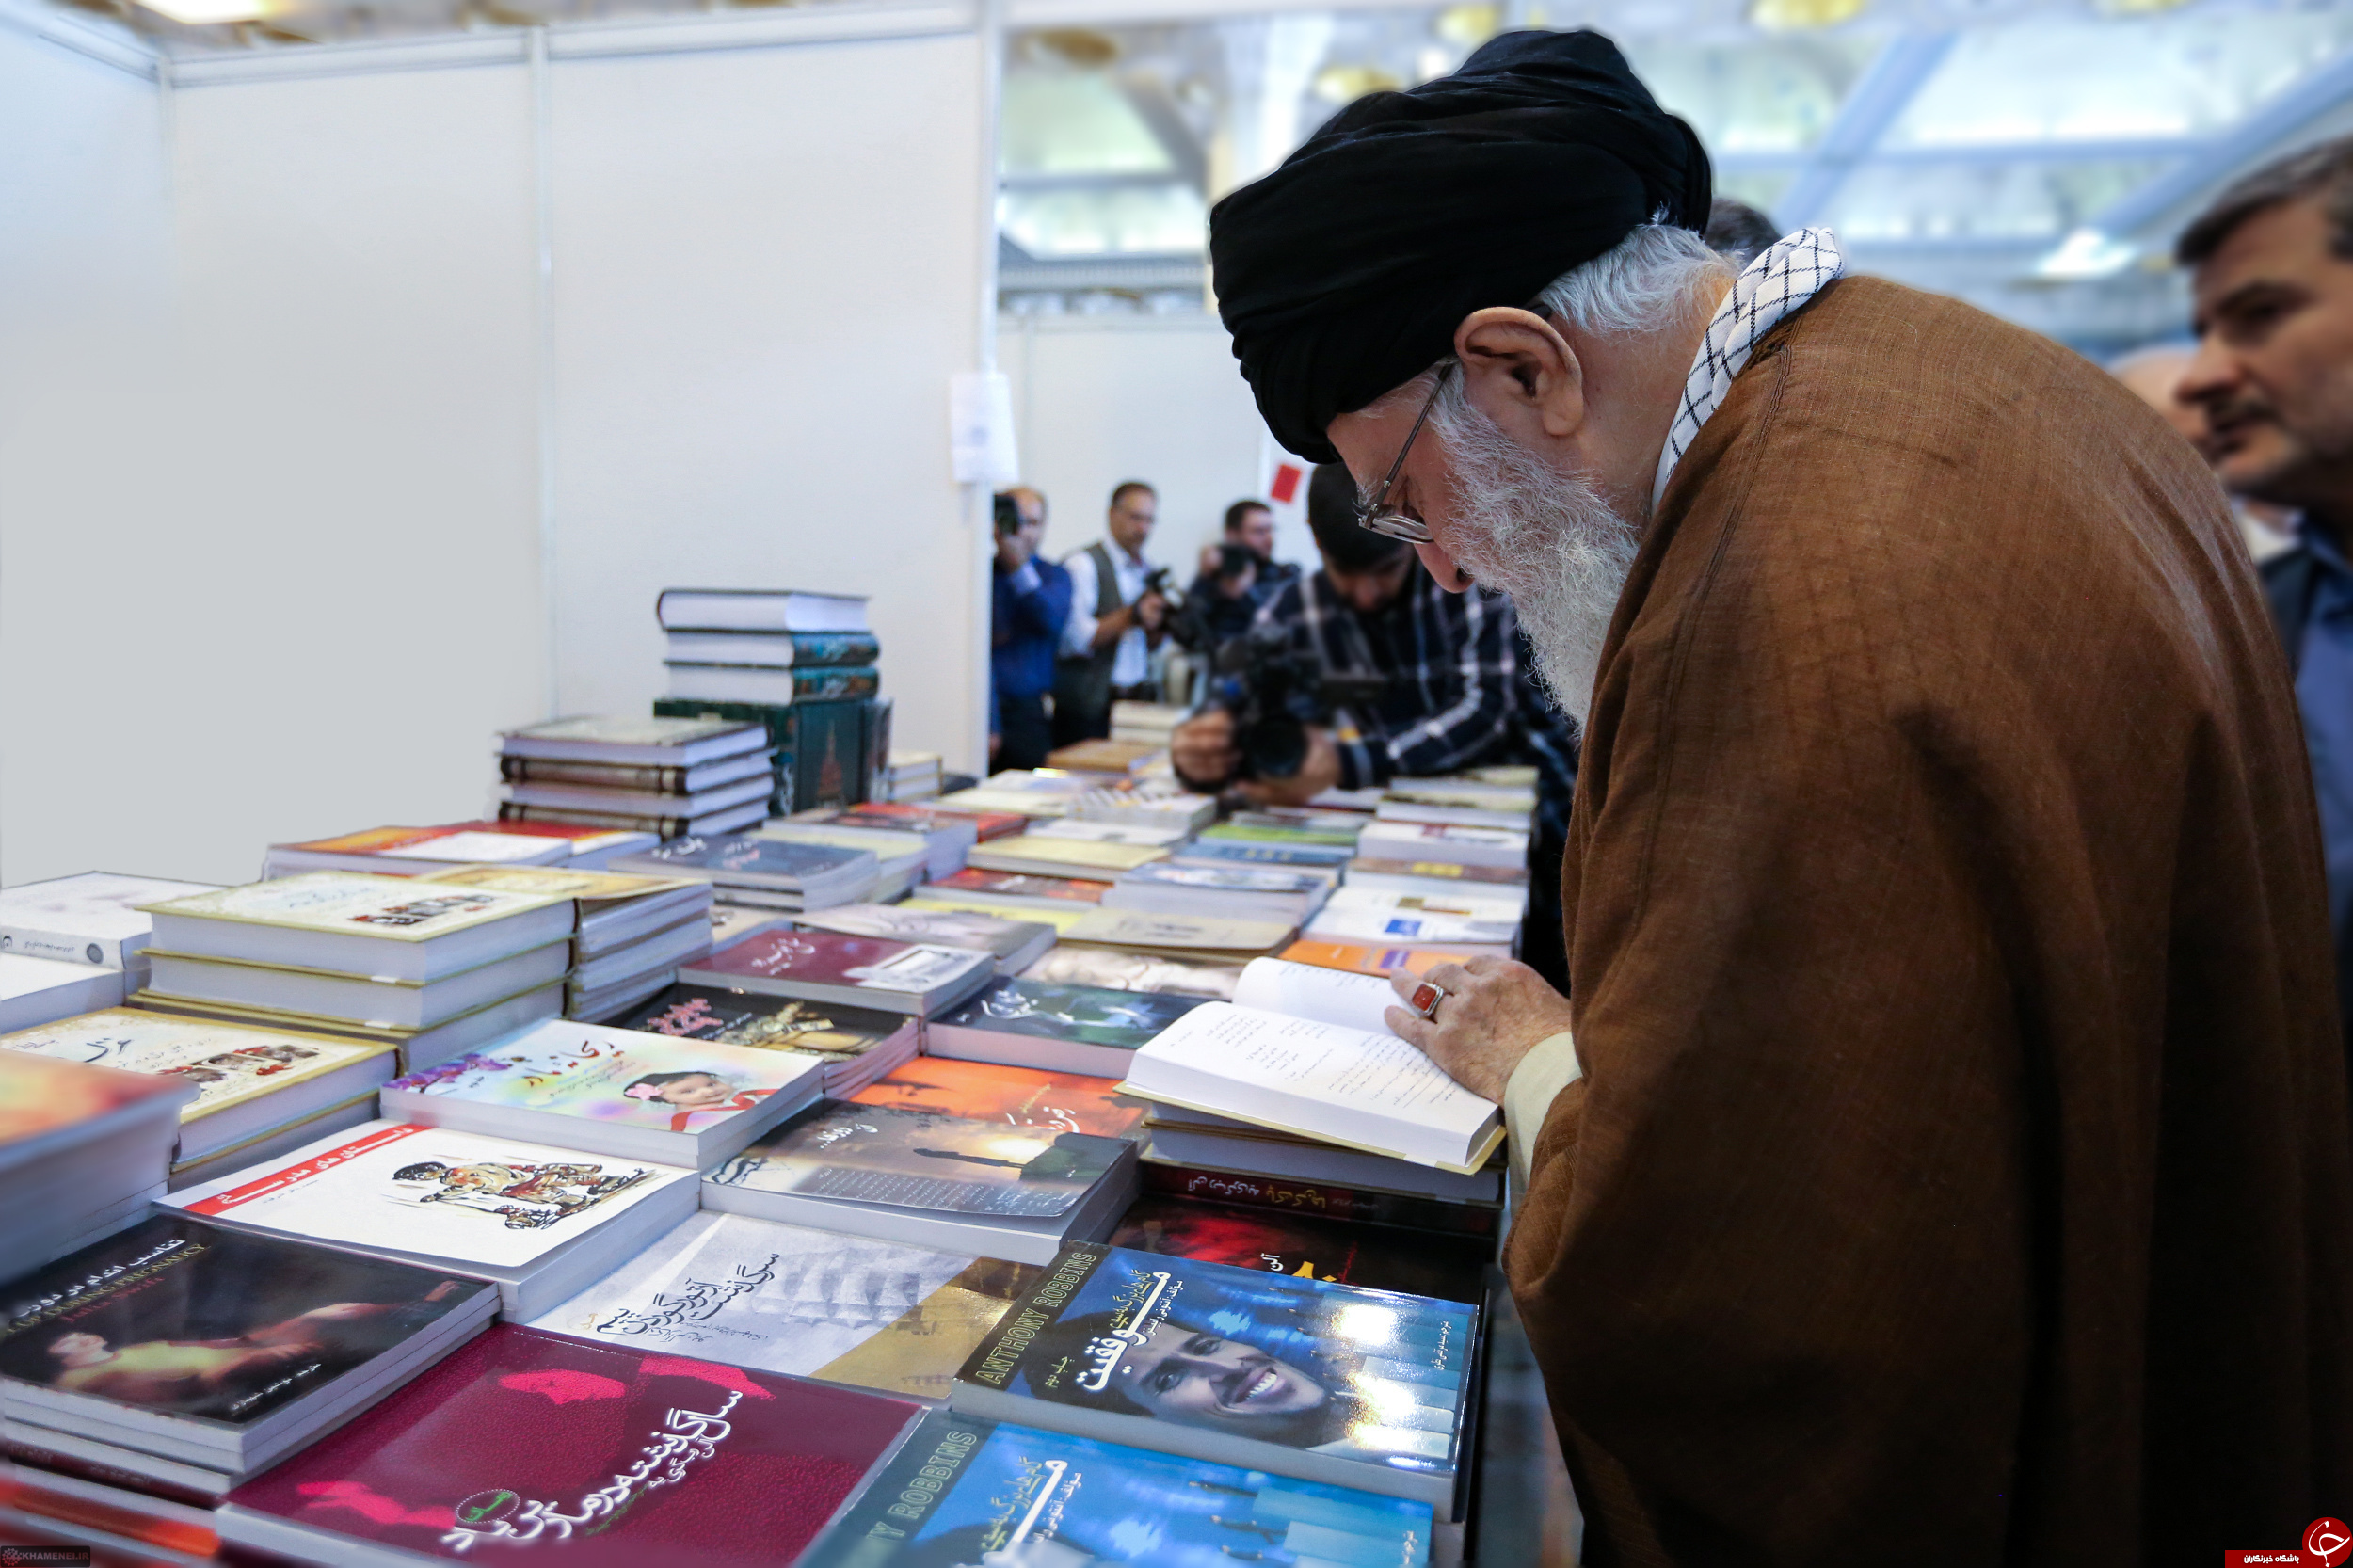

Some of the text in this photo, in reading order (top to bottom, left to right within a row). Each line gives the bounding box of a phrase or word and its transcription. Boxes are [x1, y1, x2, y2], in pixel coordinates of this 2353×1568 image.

[976, 1307, 1050, 1384] ANTHONY
[1032, 1252, 1096, 1308] ROBBINS
[1075, 1272, 1172, 1391] موفقیت
[887, 1431, 977, 1520] ROBBINS
